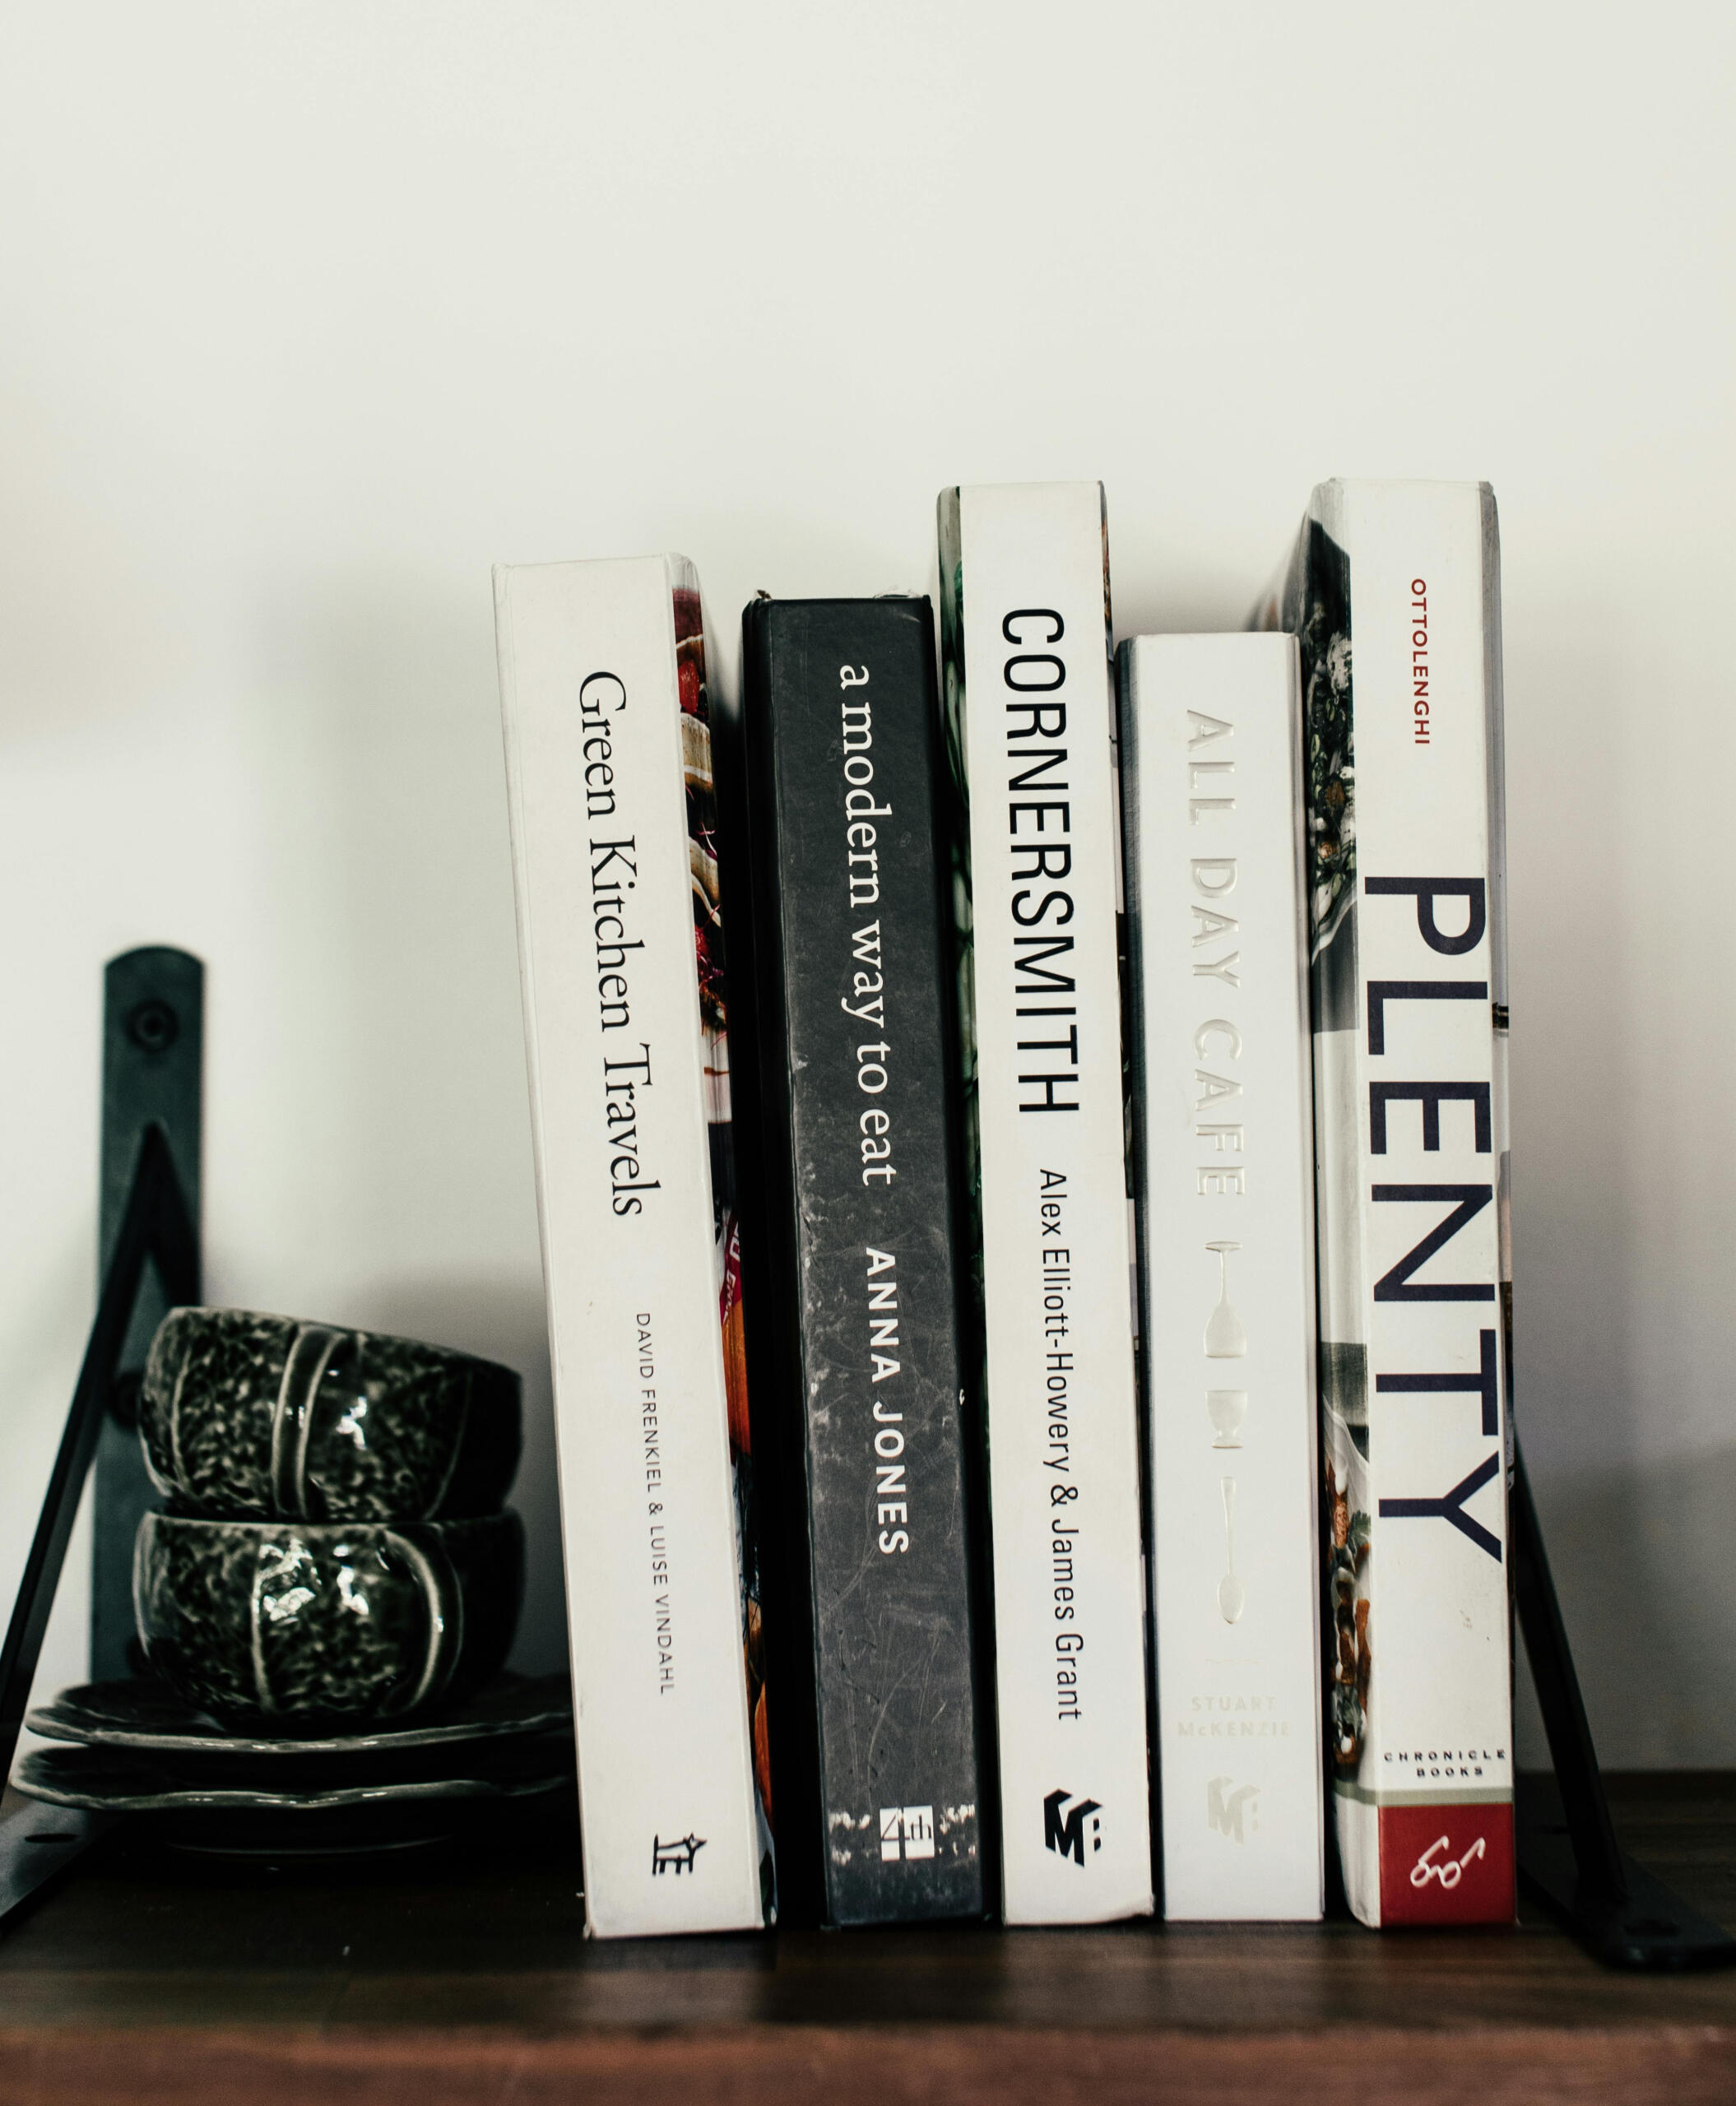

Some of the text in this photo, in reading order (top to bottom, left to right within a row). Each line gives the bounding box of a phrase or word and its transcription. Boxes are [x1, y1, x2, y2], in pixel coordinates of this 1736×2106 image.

[1410, 578, 1431, 745] OTTOLENGHI
[579, 670, 661, 1217] Green Kitchen Travels
[839, 665, 897, 1186] a modern way to eat
[1001, 608, 1081, 1114] CORNERSMITH
[1186, 708, 1245, 1196] ALL DAY CAFE
[866, 1246, 909, 1554] ANNA JONES
[1364, 876, 1503, 1563] PLENTY
[636, 1313, 675, 1695] DAVID FRENKIEL & LUISE VINDAHL
[1039, 1168, 1084, 1721] Alex Elliott-Howery & James Grant
[1178, 1721, 1291, 1738] McKENZIE
[1191, 1695, 1276, 1712] STUART
[1384, 1749, 1506, 1763] CHRONICLE
[1417, 1766, 1484, 1778] BOOKS
